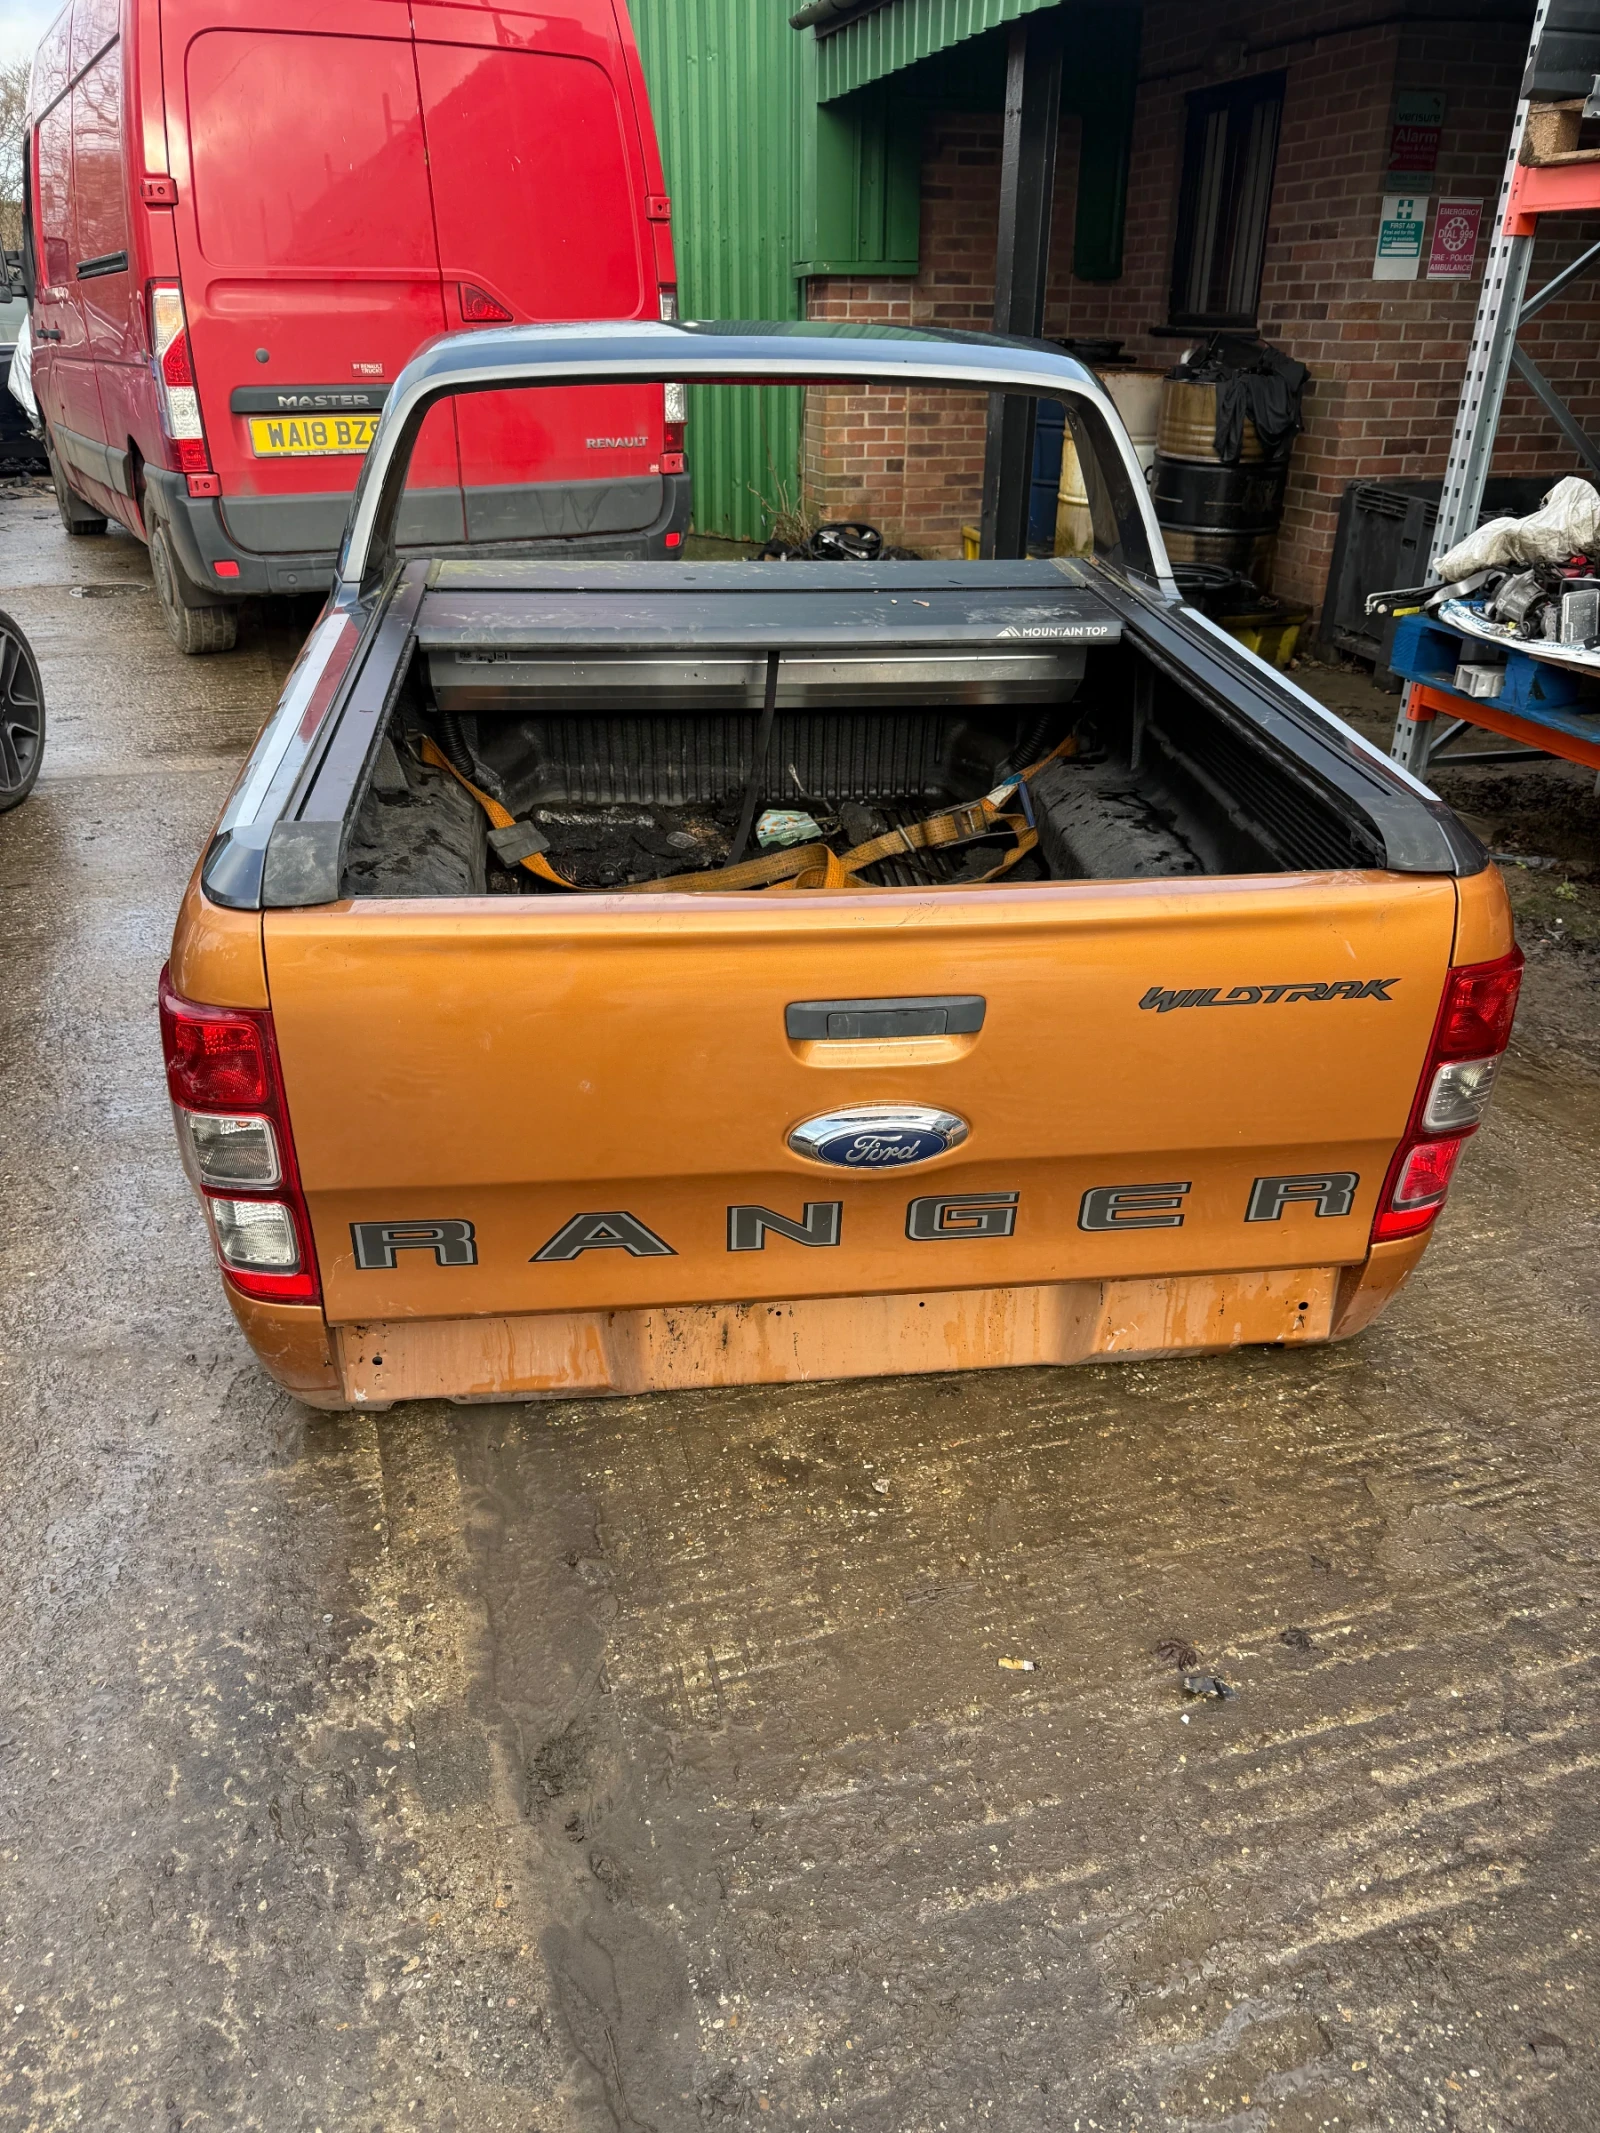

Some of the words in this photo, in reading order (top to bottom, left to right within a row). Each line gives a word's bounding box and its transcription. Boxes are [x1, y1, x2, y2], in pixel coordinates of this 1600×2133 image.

[1396, 129, 1438, 143] Alarm
[1440, 208, 1480, 216] EMERGENCY
[1438, 229, 1457, 238] DIAL
[1460, 230, 1474, 239] 999
[1430, 253, 1445, 261] FIRE
[1449, 254, 1474, 262] POLICE
[1429, 263, 1472, 271] AMBULANCE
[277, 394, 370, 407] MASTER
[266, 421, 328, 448] WA18
[586, 436, 649, 449] RENAULT
[1022, 626, 1083, 637] MOUNTAIN
[1085, 626, 1108, 636] TOP
[1138, 977, 1402, 1013] WILDTRAK
[845, 1135, 921, 1163] Ford
[349, 1171, 1360, 1271] RANGER
